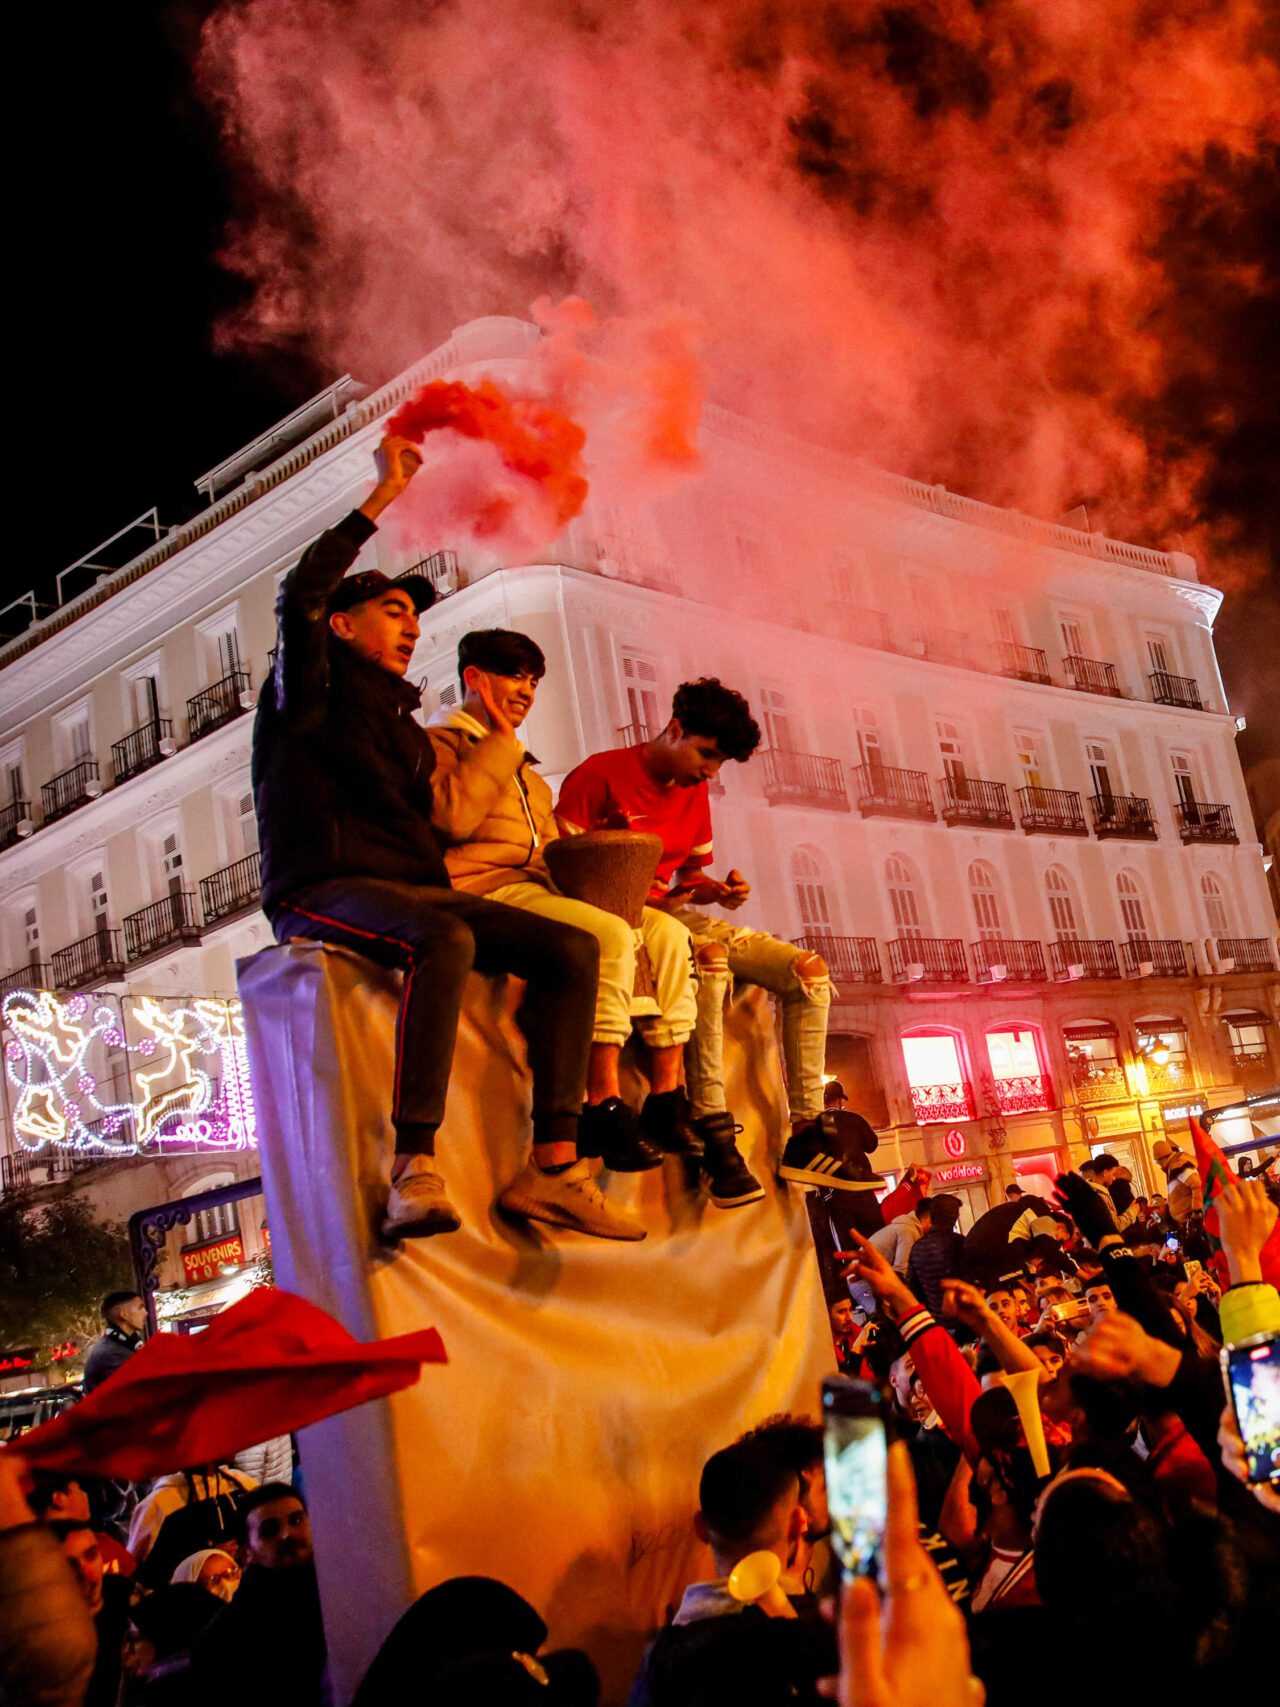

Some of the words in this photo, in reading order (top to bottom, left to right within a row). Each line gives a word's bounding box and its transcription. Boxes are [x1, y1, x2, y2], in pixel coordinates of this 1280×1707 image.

[941, 1165, 983, 1181] vodafone
[184, 1240, 242, 1270] SOUVENIRS
[919, 1523, 971, 1602] NIK
